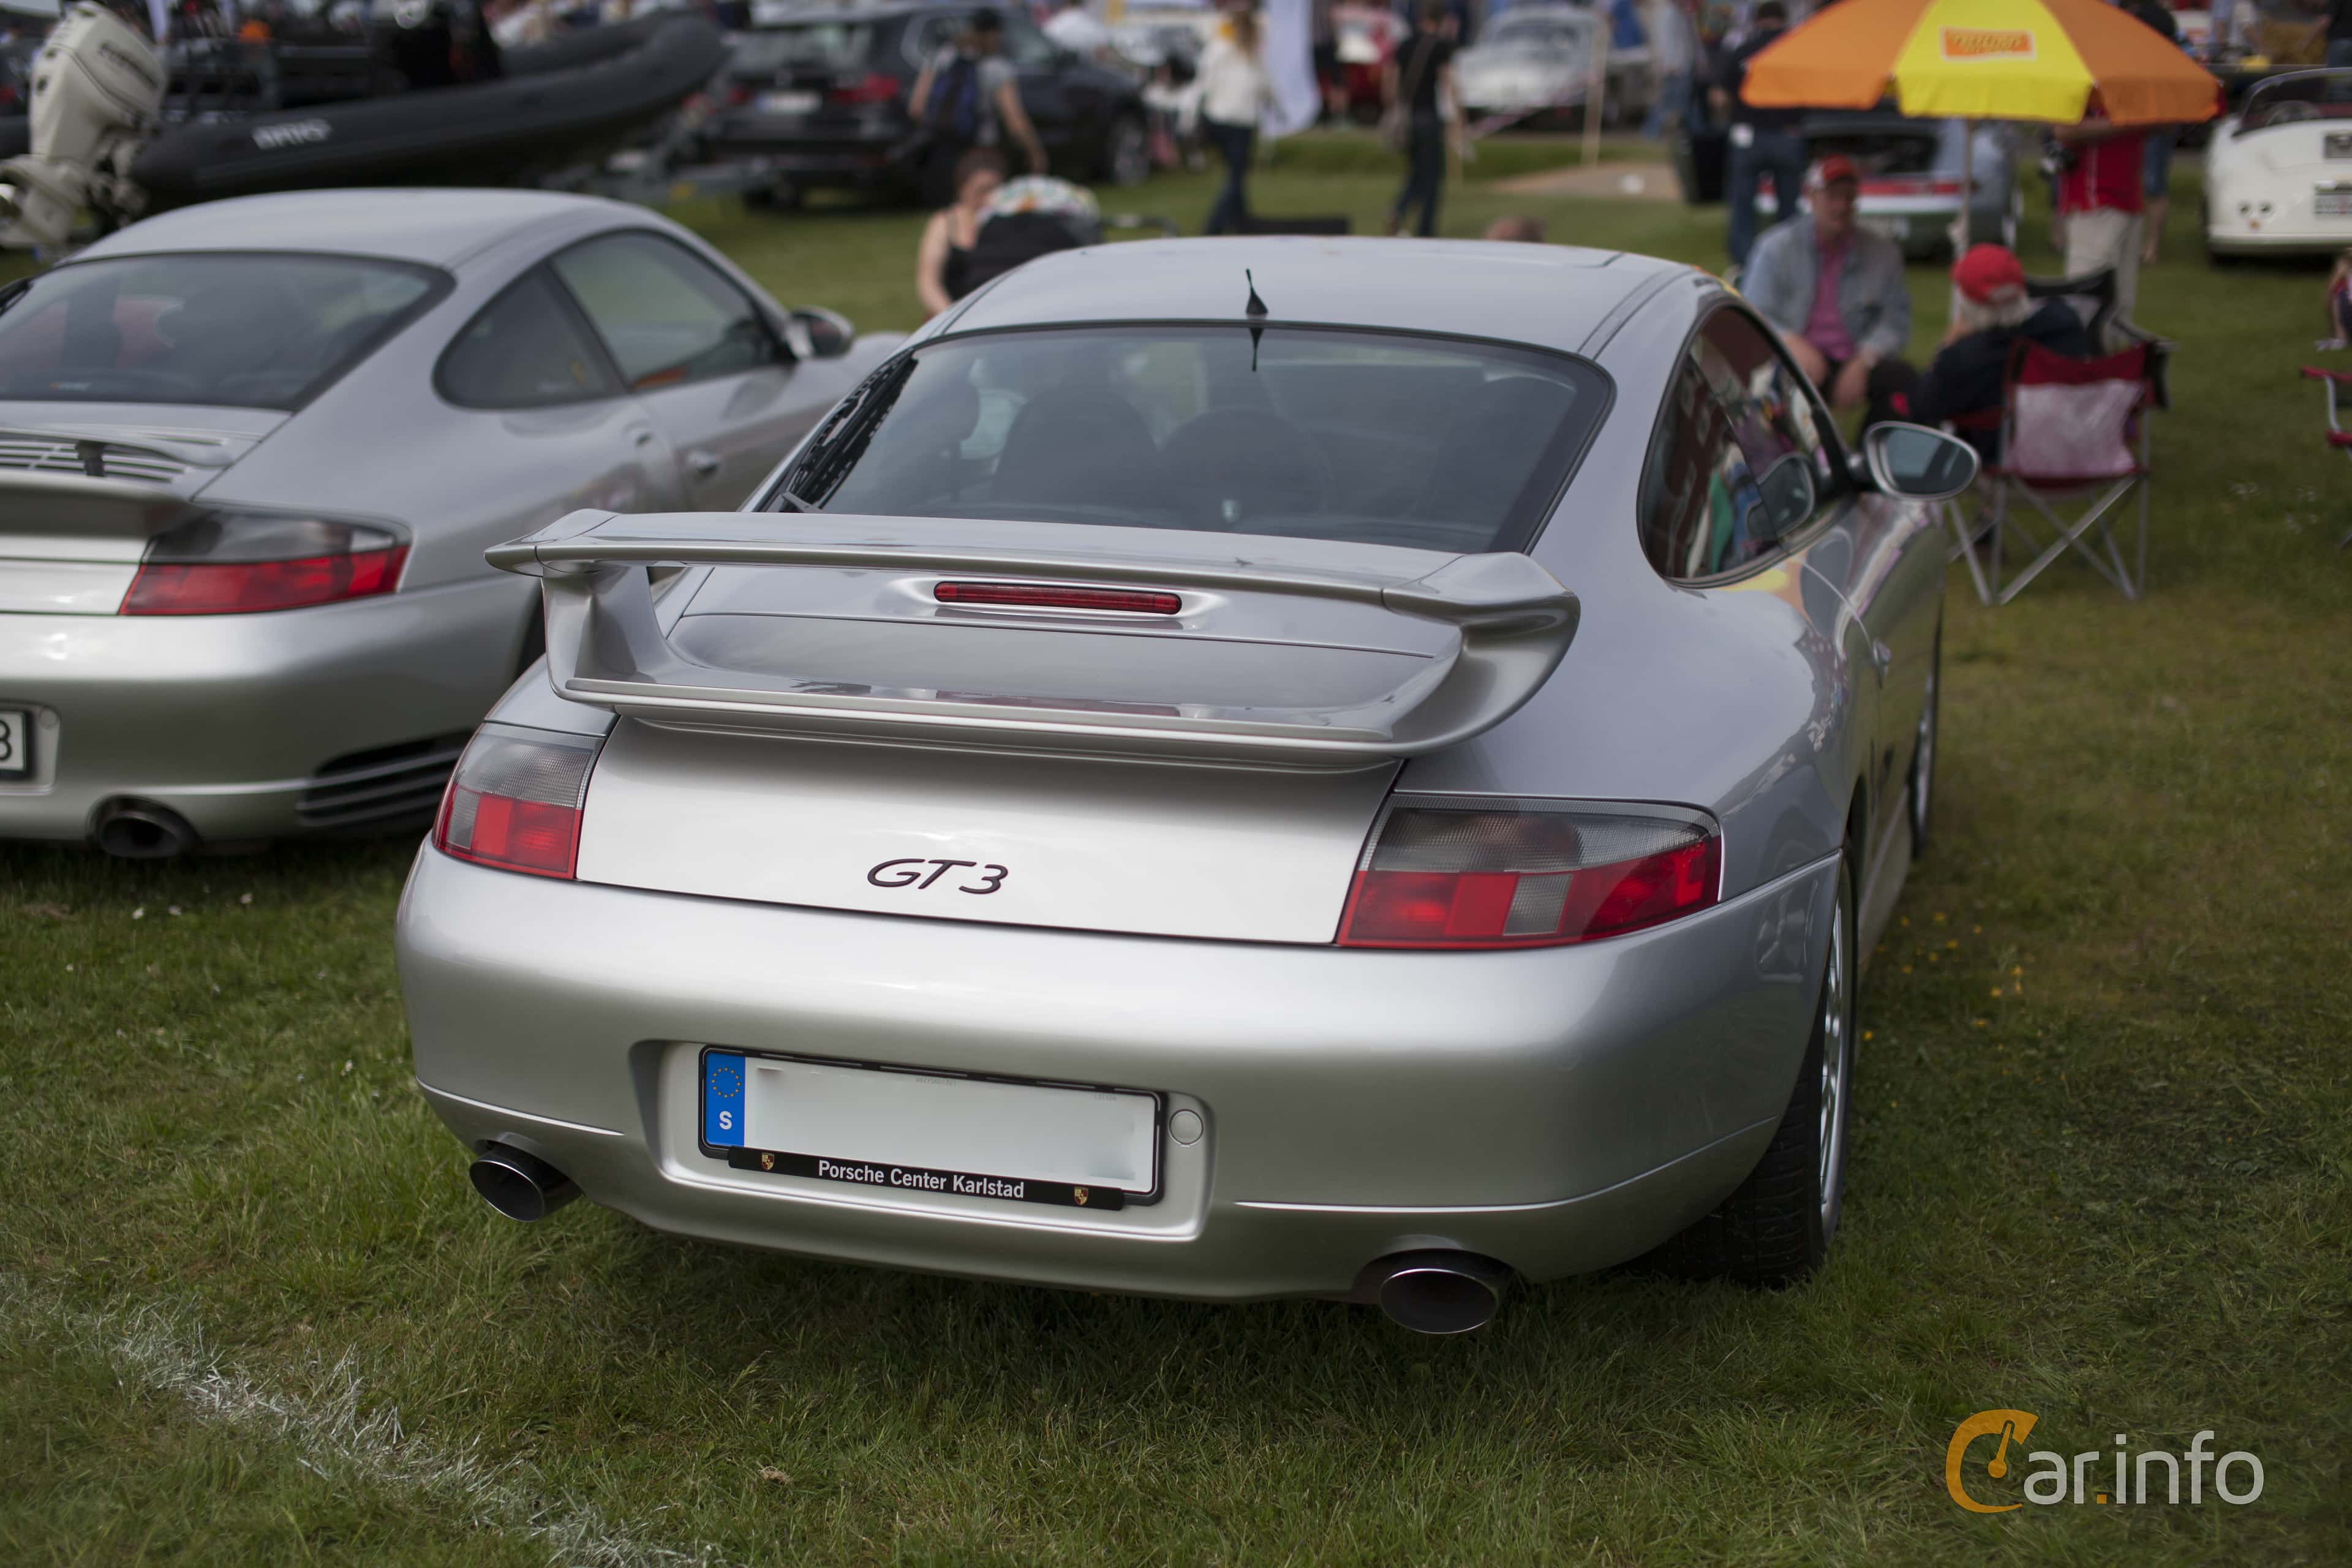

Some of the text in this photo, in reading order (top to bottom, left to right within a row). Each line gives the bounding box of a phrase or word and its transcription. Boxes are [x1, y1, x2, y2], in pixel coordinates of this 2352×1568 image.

[719, 1110, 732, 1129] S
[818, 1159, 1024, 1199] Porsche Center Karlstad
